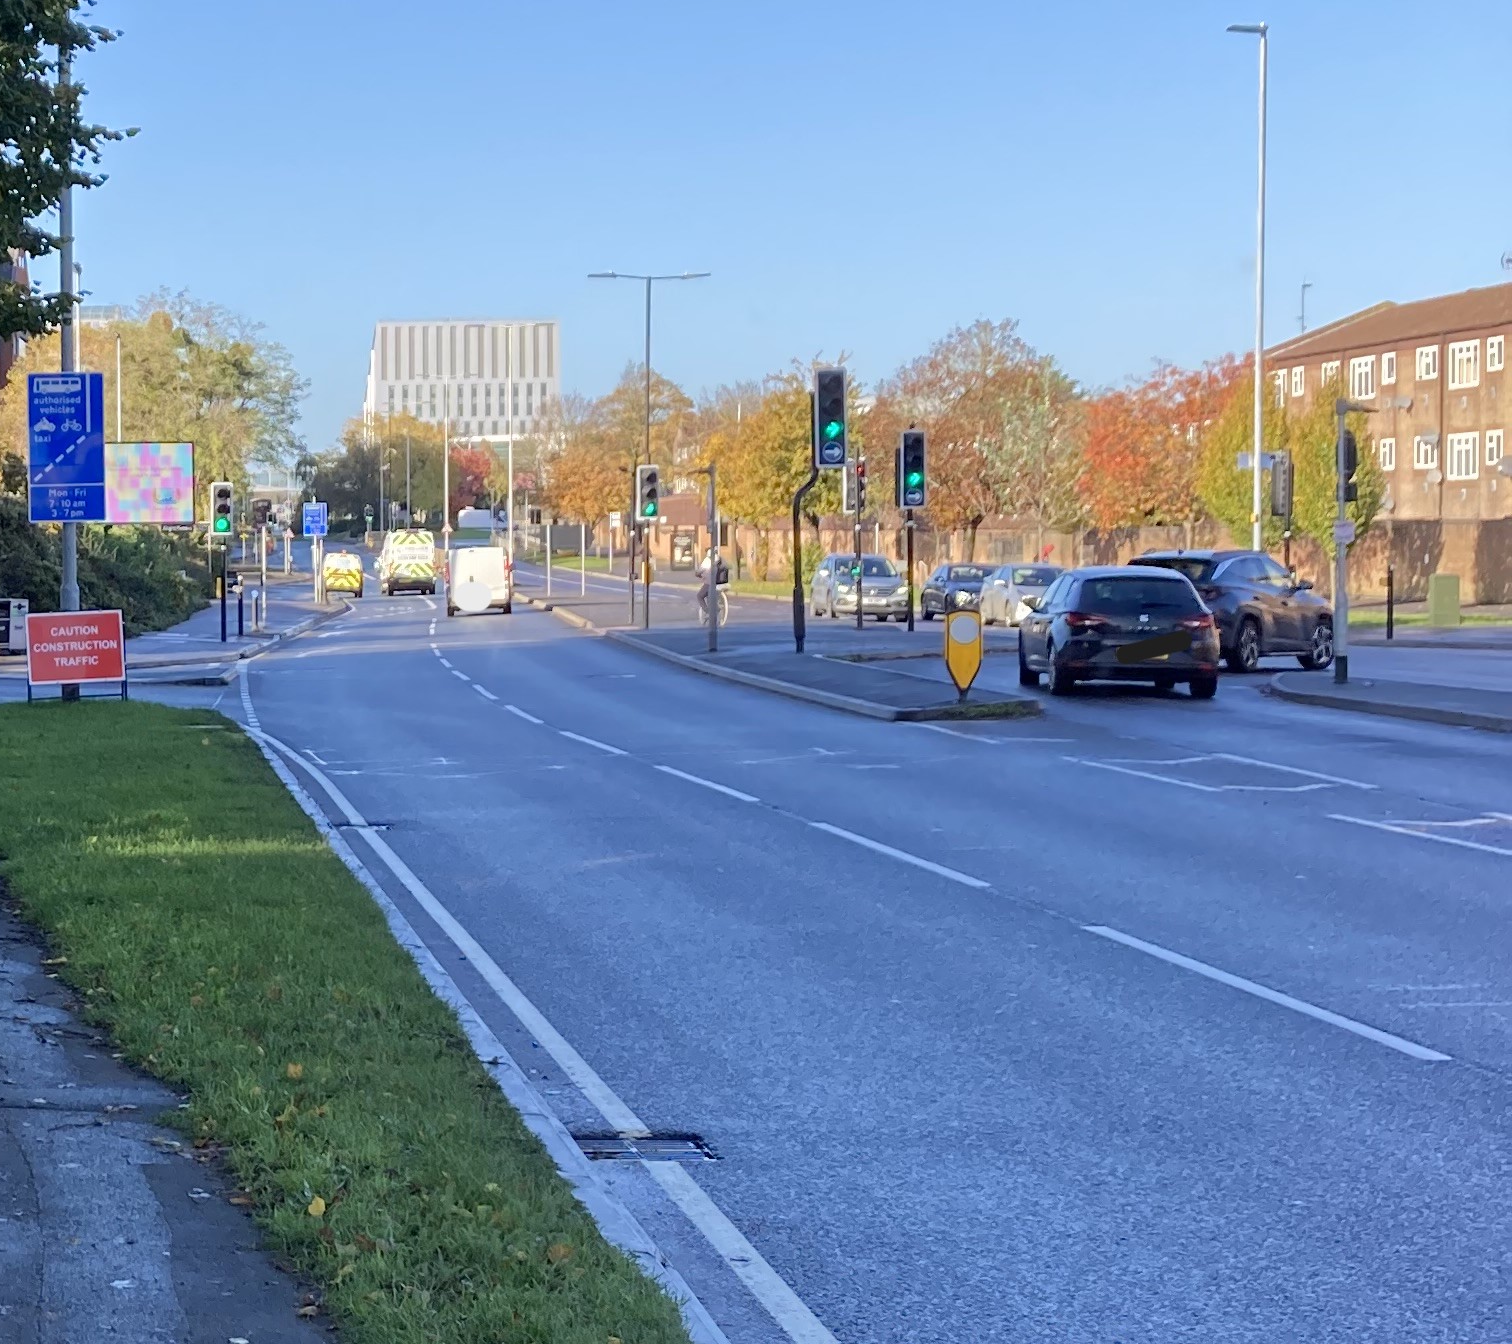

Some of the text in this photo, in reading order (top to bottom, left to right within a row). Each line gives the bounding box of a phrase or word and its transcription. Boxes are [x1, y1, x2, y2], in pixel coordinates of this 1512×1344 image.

[33, 396, 81, 404] authorised
[39, 405, 75, 414] vehicles
[34, 434, 51, 443] taxi
[48, 488, 68, 497] Mon
[74, 488, 87, 497] Fri
[61, 499, 71, 508] 10
[72, 500, 86, 508] am
[70, 510, 85, 518] pm
[50, 625, 99, 636] CAUTION
[33, 640, 118, 653] CONSTRUCTION
[53, 656, 99, 667] TRAFFIC
